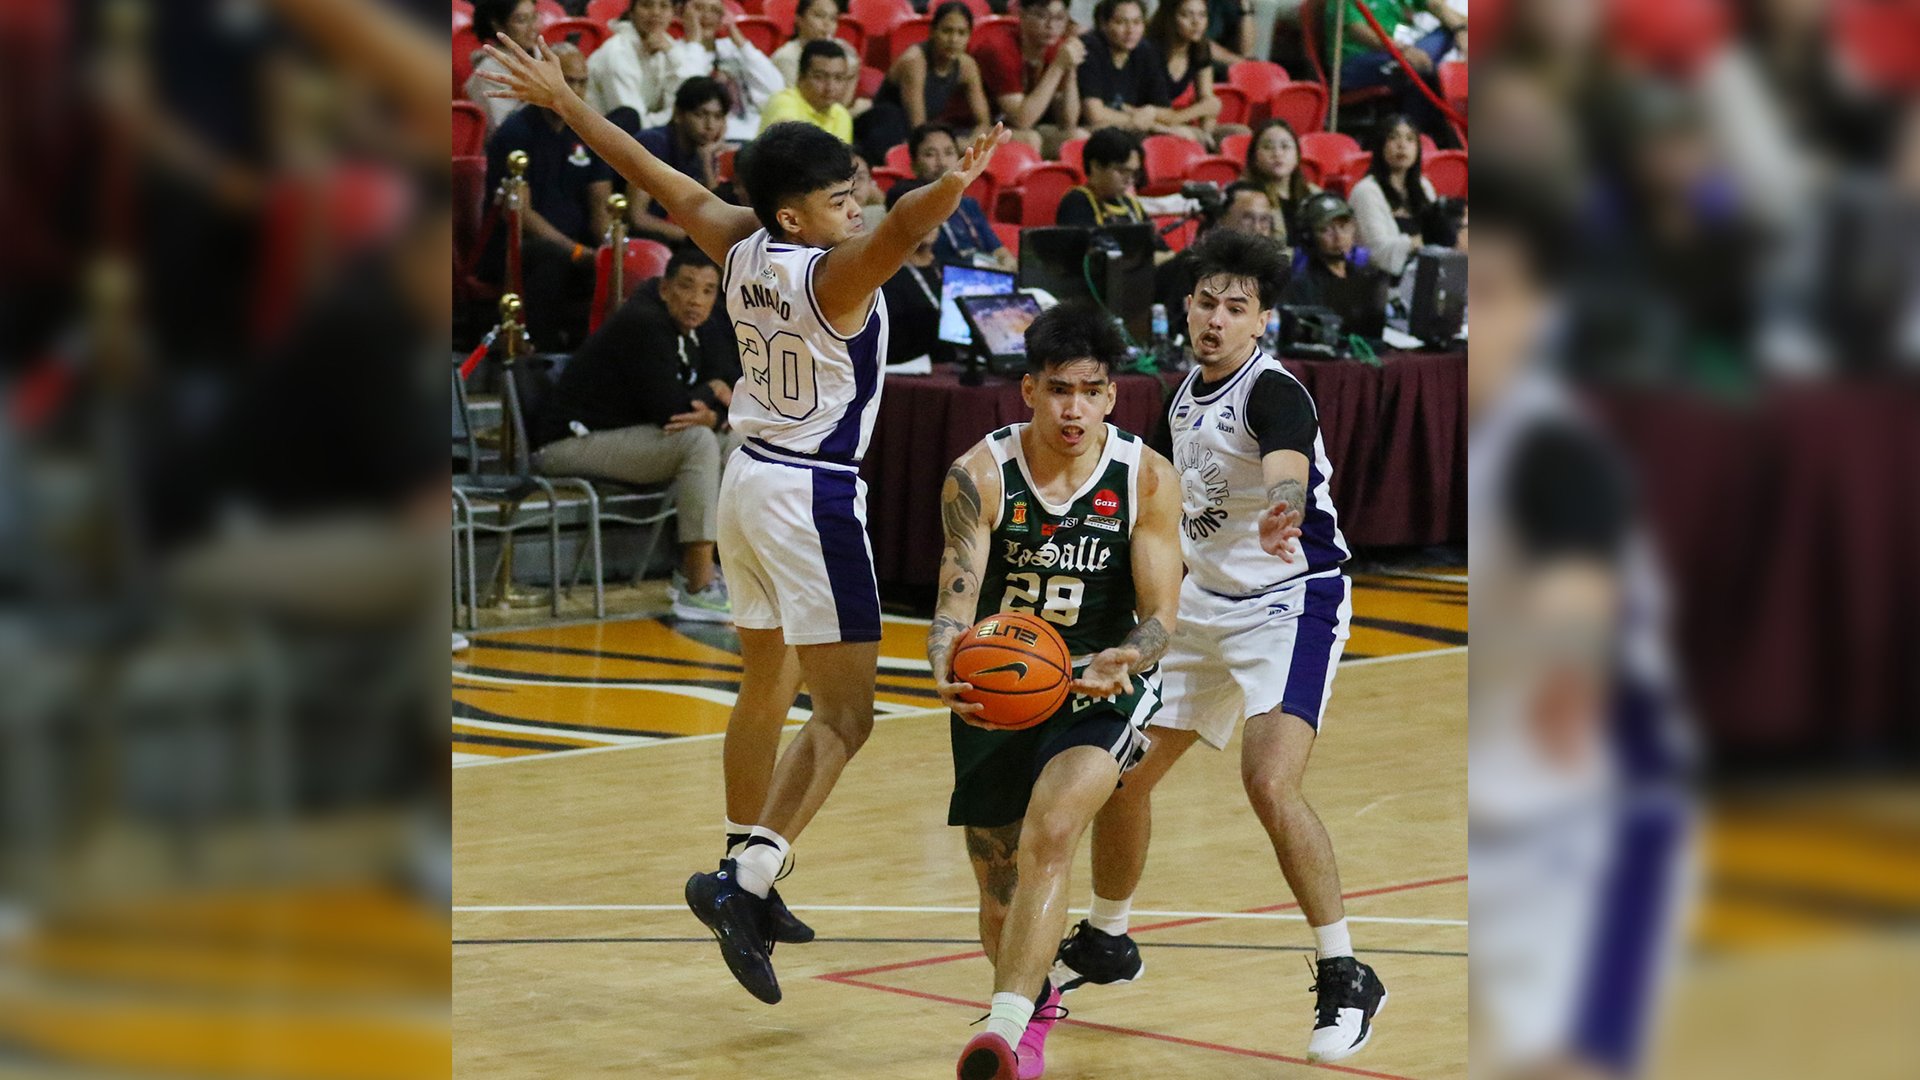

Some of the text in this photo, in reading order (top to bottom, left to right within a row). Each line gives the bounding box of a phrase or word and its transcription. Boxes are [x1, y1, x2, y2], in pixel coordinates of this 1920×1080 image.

[734, 320, 818, 421] 20
[1094, 498, 1117, 508] Gazz
[999, 572, 1085, 627] 28
[976, 620, 1038, 648] ELITE
